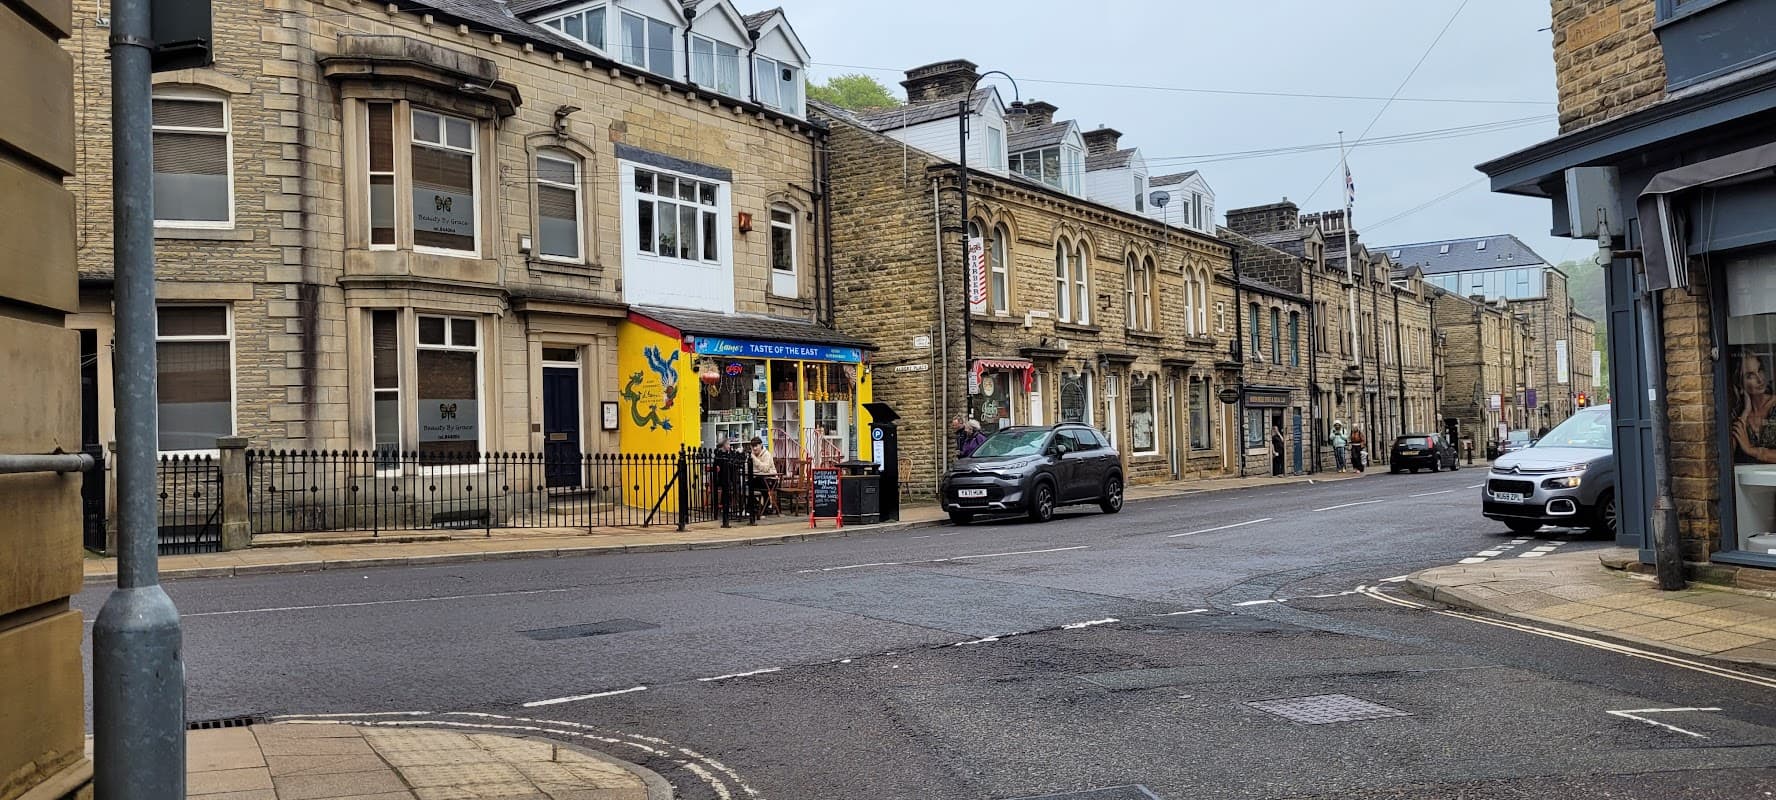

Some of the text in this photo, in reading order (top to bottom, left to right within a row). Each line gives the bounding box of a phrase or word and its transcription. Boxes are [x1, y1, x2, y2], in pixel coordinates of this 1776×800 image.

[971, 255, 979, 301] BARBERS
[749, 344, 773, 353] TASTE
[774, 346, 784, 354] OF
[785, 346, 800, 355] THE
[800, 347, 818, 356] EAST
[726, 365, 743, 374] OPEN
